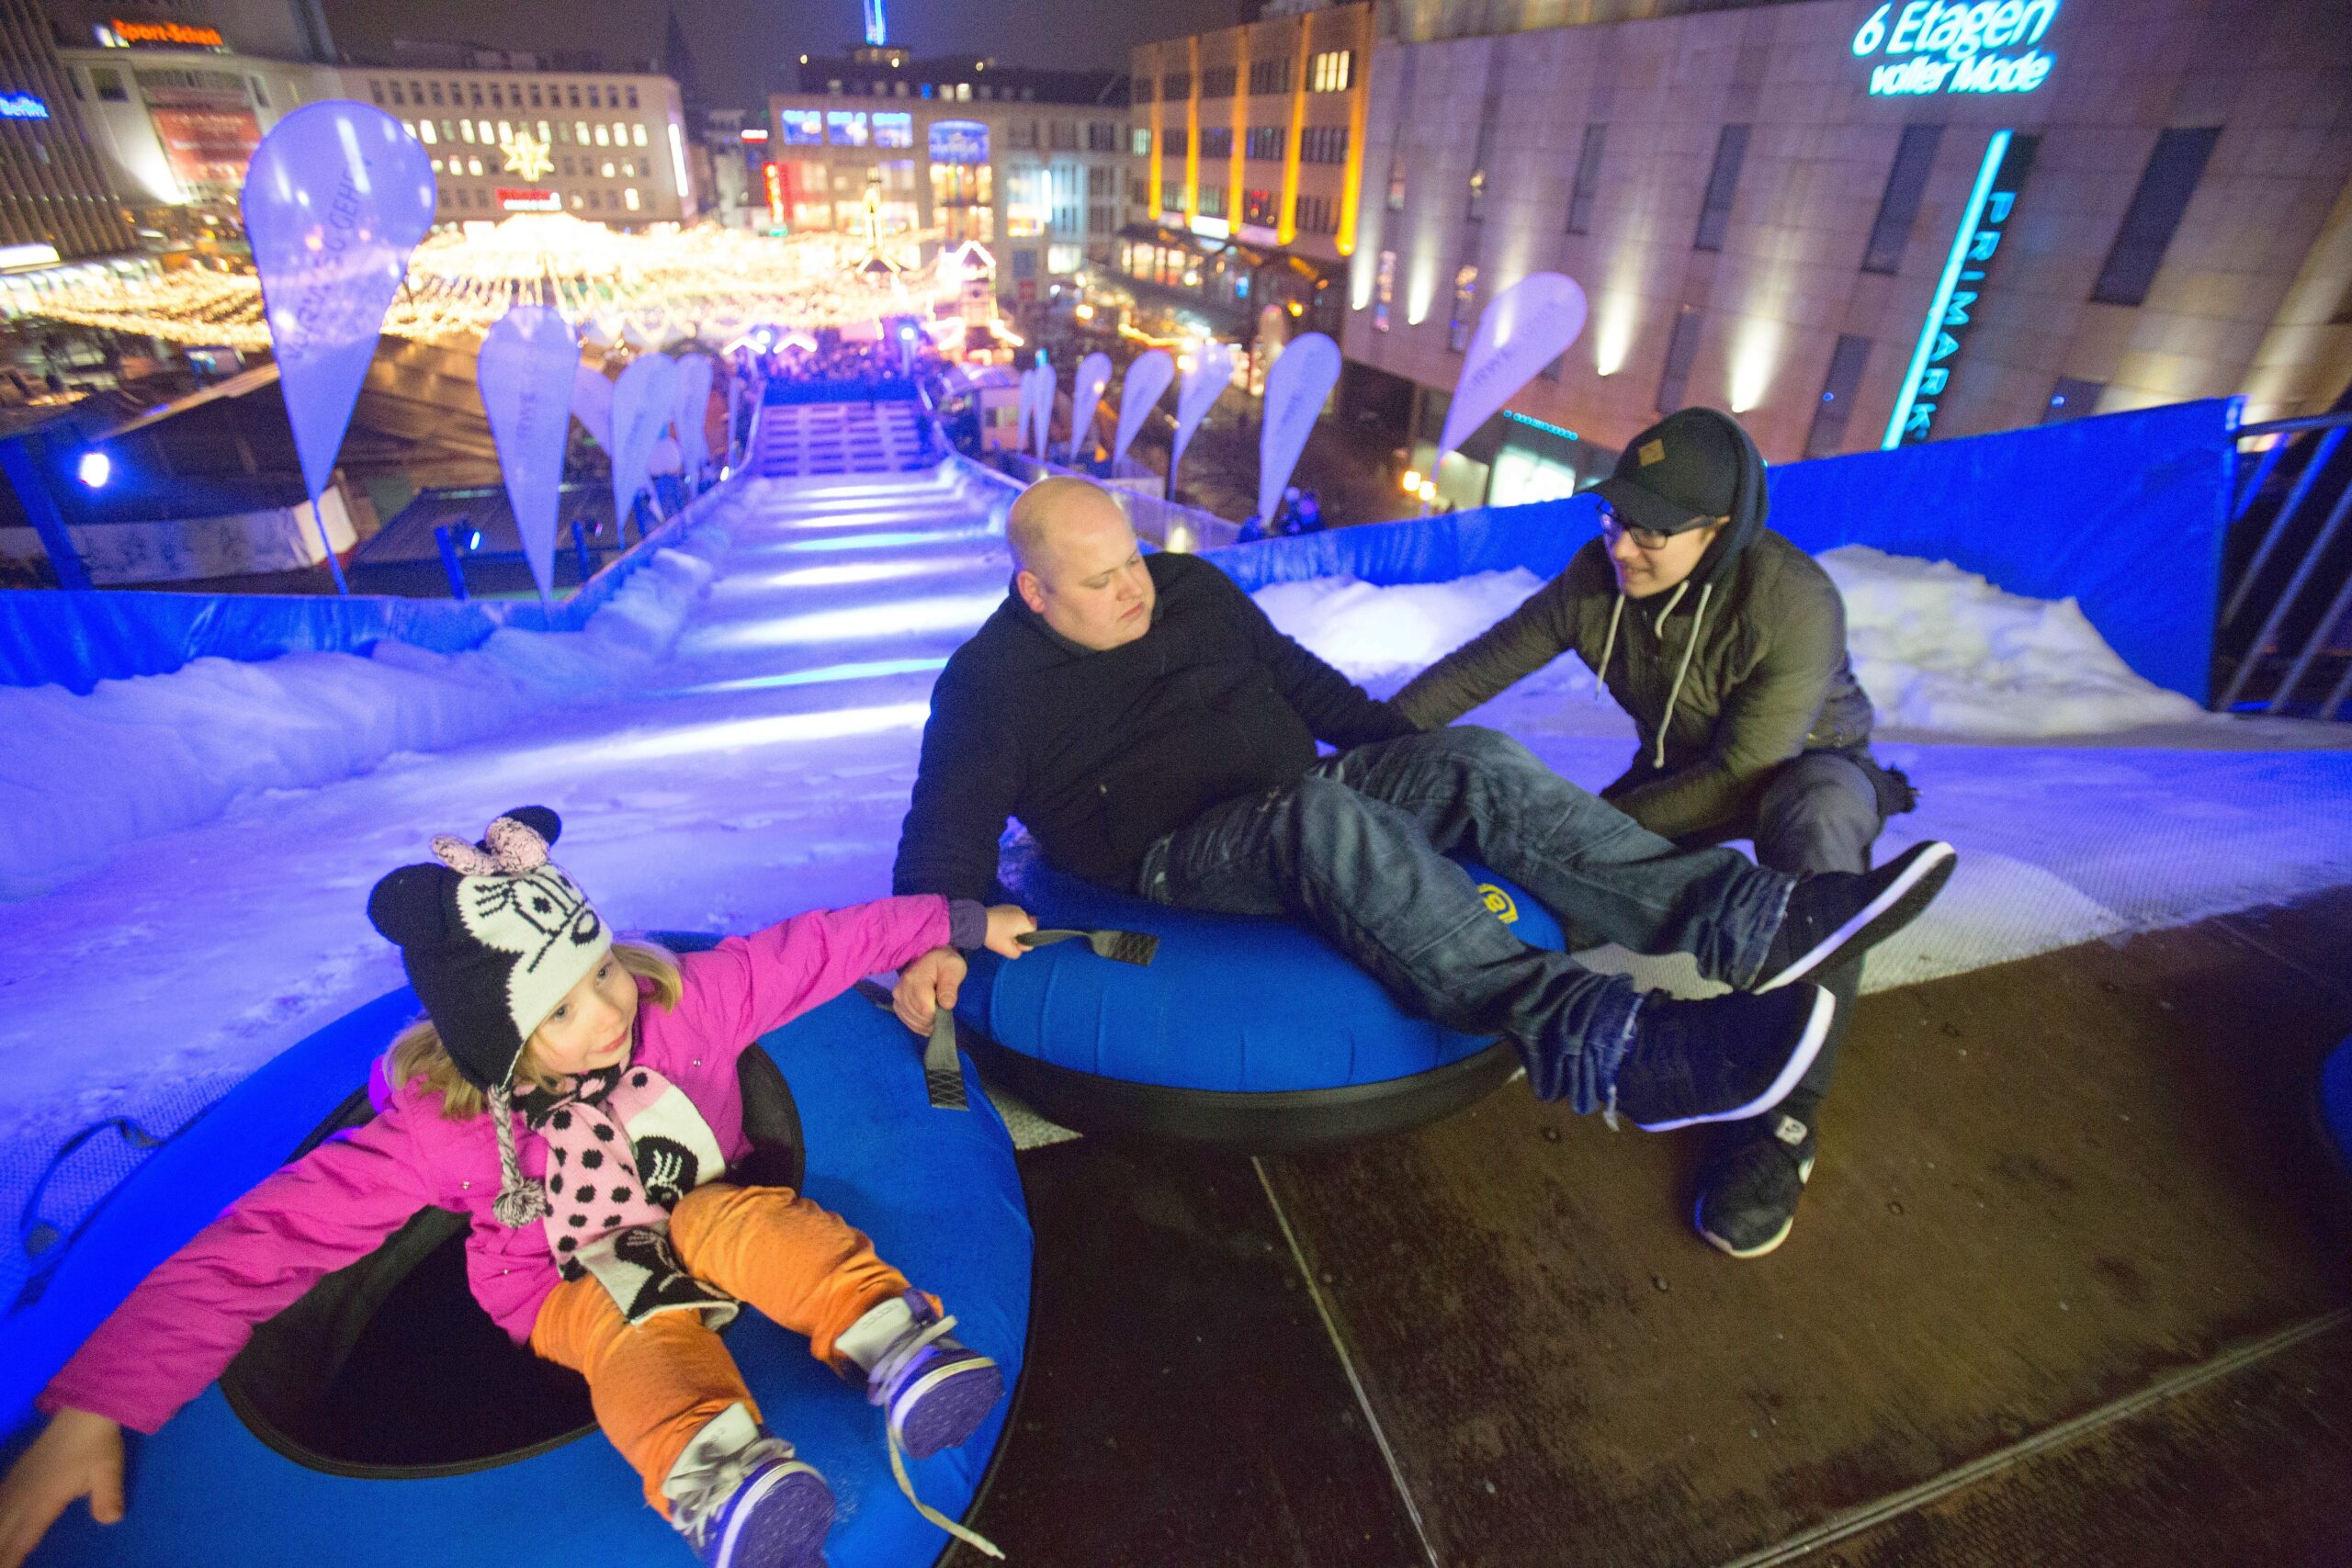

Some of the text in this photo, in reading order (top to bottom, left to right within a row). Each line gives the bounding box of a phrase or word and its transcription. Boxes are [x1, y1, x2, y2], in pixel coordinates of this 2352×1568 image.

[1852, 0, 2058, 62] 6 Etagen
[1869, 49, 2055, 96] voller Mode
[1904, 191, 2017, 435] PRIMARK
